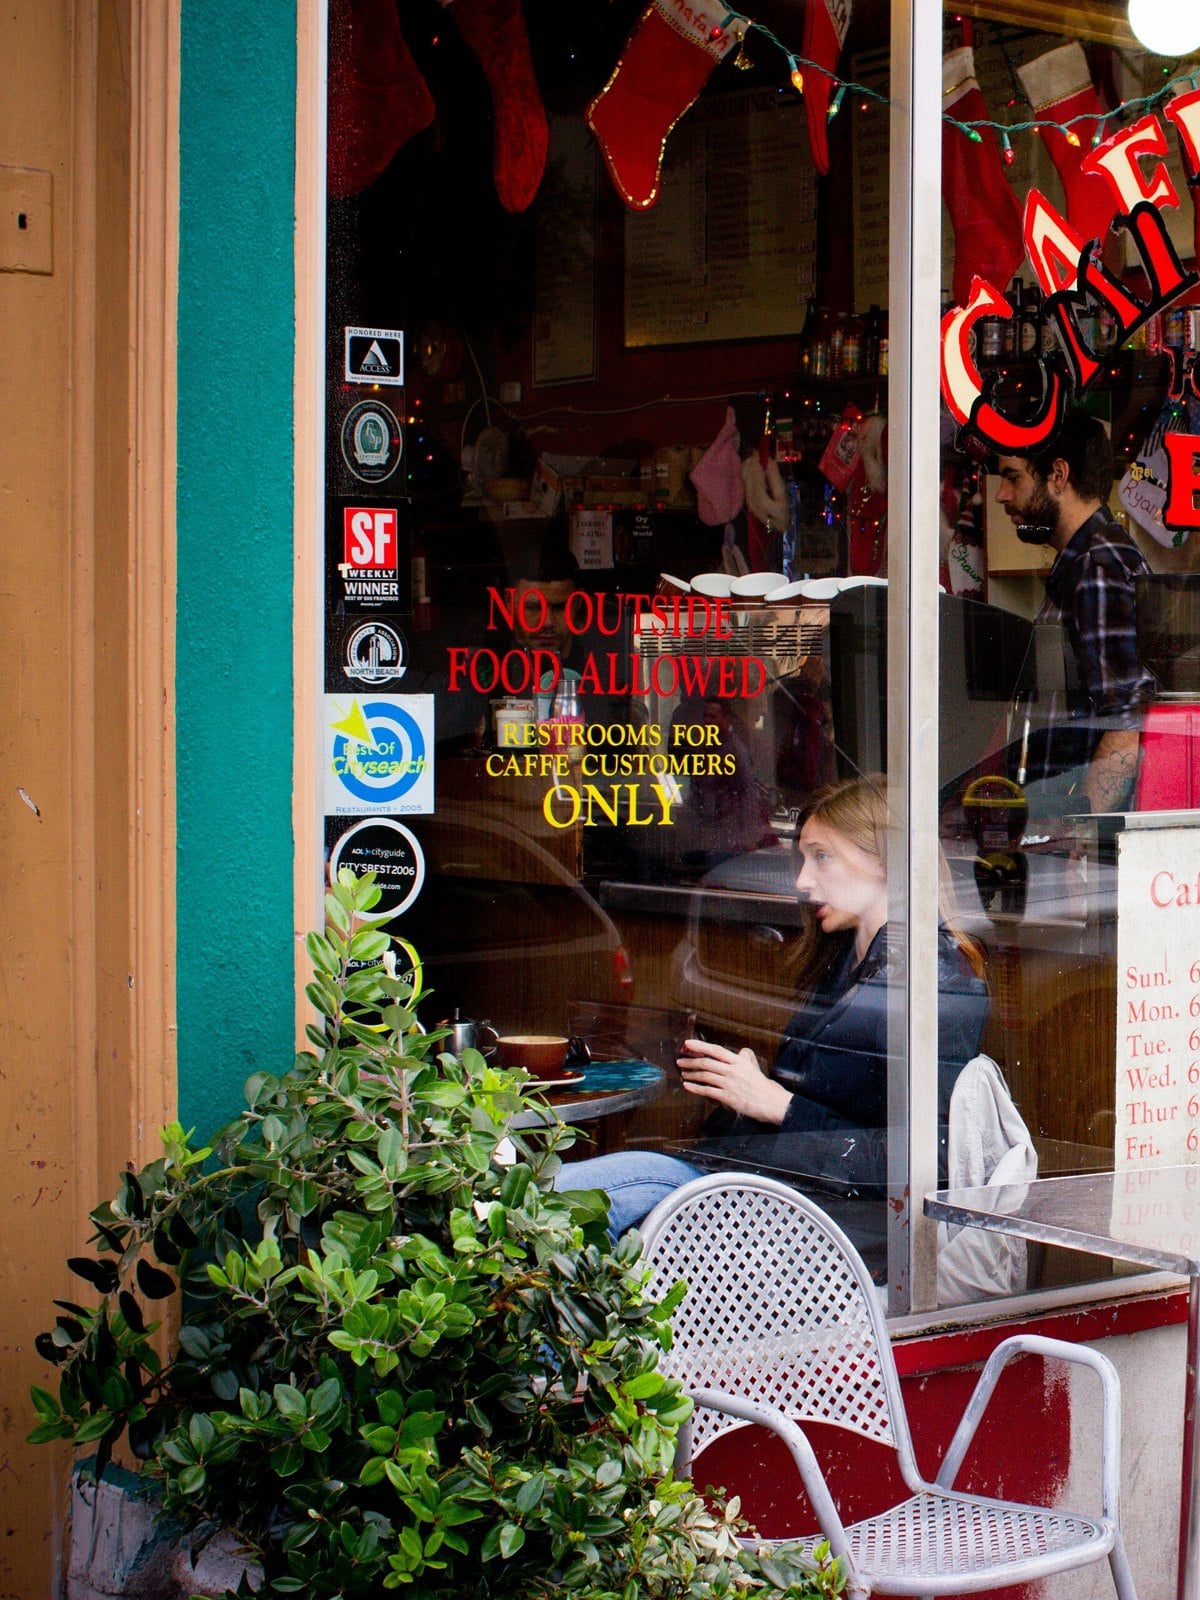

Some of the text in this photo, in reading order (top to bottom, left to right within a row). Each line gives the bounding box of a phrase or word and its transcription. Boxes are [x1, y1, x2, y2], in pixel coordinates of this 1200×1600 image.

[348, 328, 401, 339] HONORED HERE
[360, 364, 390, 373] ACCESS
[351, 511, 393, 565] SF
[348, 569, 395, 578] WEEKLY
[344, 582, 399, 595] WINNER
[487, 585, 734, 641] NO OUTSIDE
[350, 667, 400, 676] NORTH BEACH
[447, 647, 767, 699] FOOD ALLOWED
[503, 723, 721, 746] RESTROOMS FOR
[343, 741, 396, 756] Best Of
[330, 754, 429, 779] Citysearch
[486, 754, 736, 777] CAFFE CUSTOMERS
[399, 804, 423, 813] 2005
[543, 783, 683, 829] ONLY
[1126, 966, 1172, 989] Sun.
[1127, 999, 1179, 1024] Mon.
[1126, 1034, 1171, 1058] Tue.
[1126, 1063, 1177, 1091] Wed.
[1125, 1100, 1178, 1126] Thur
[1126, 1135, 1160, 1160] Fri.
